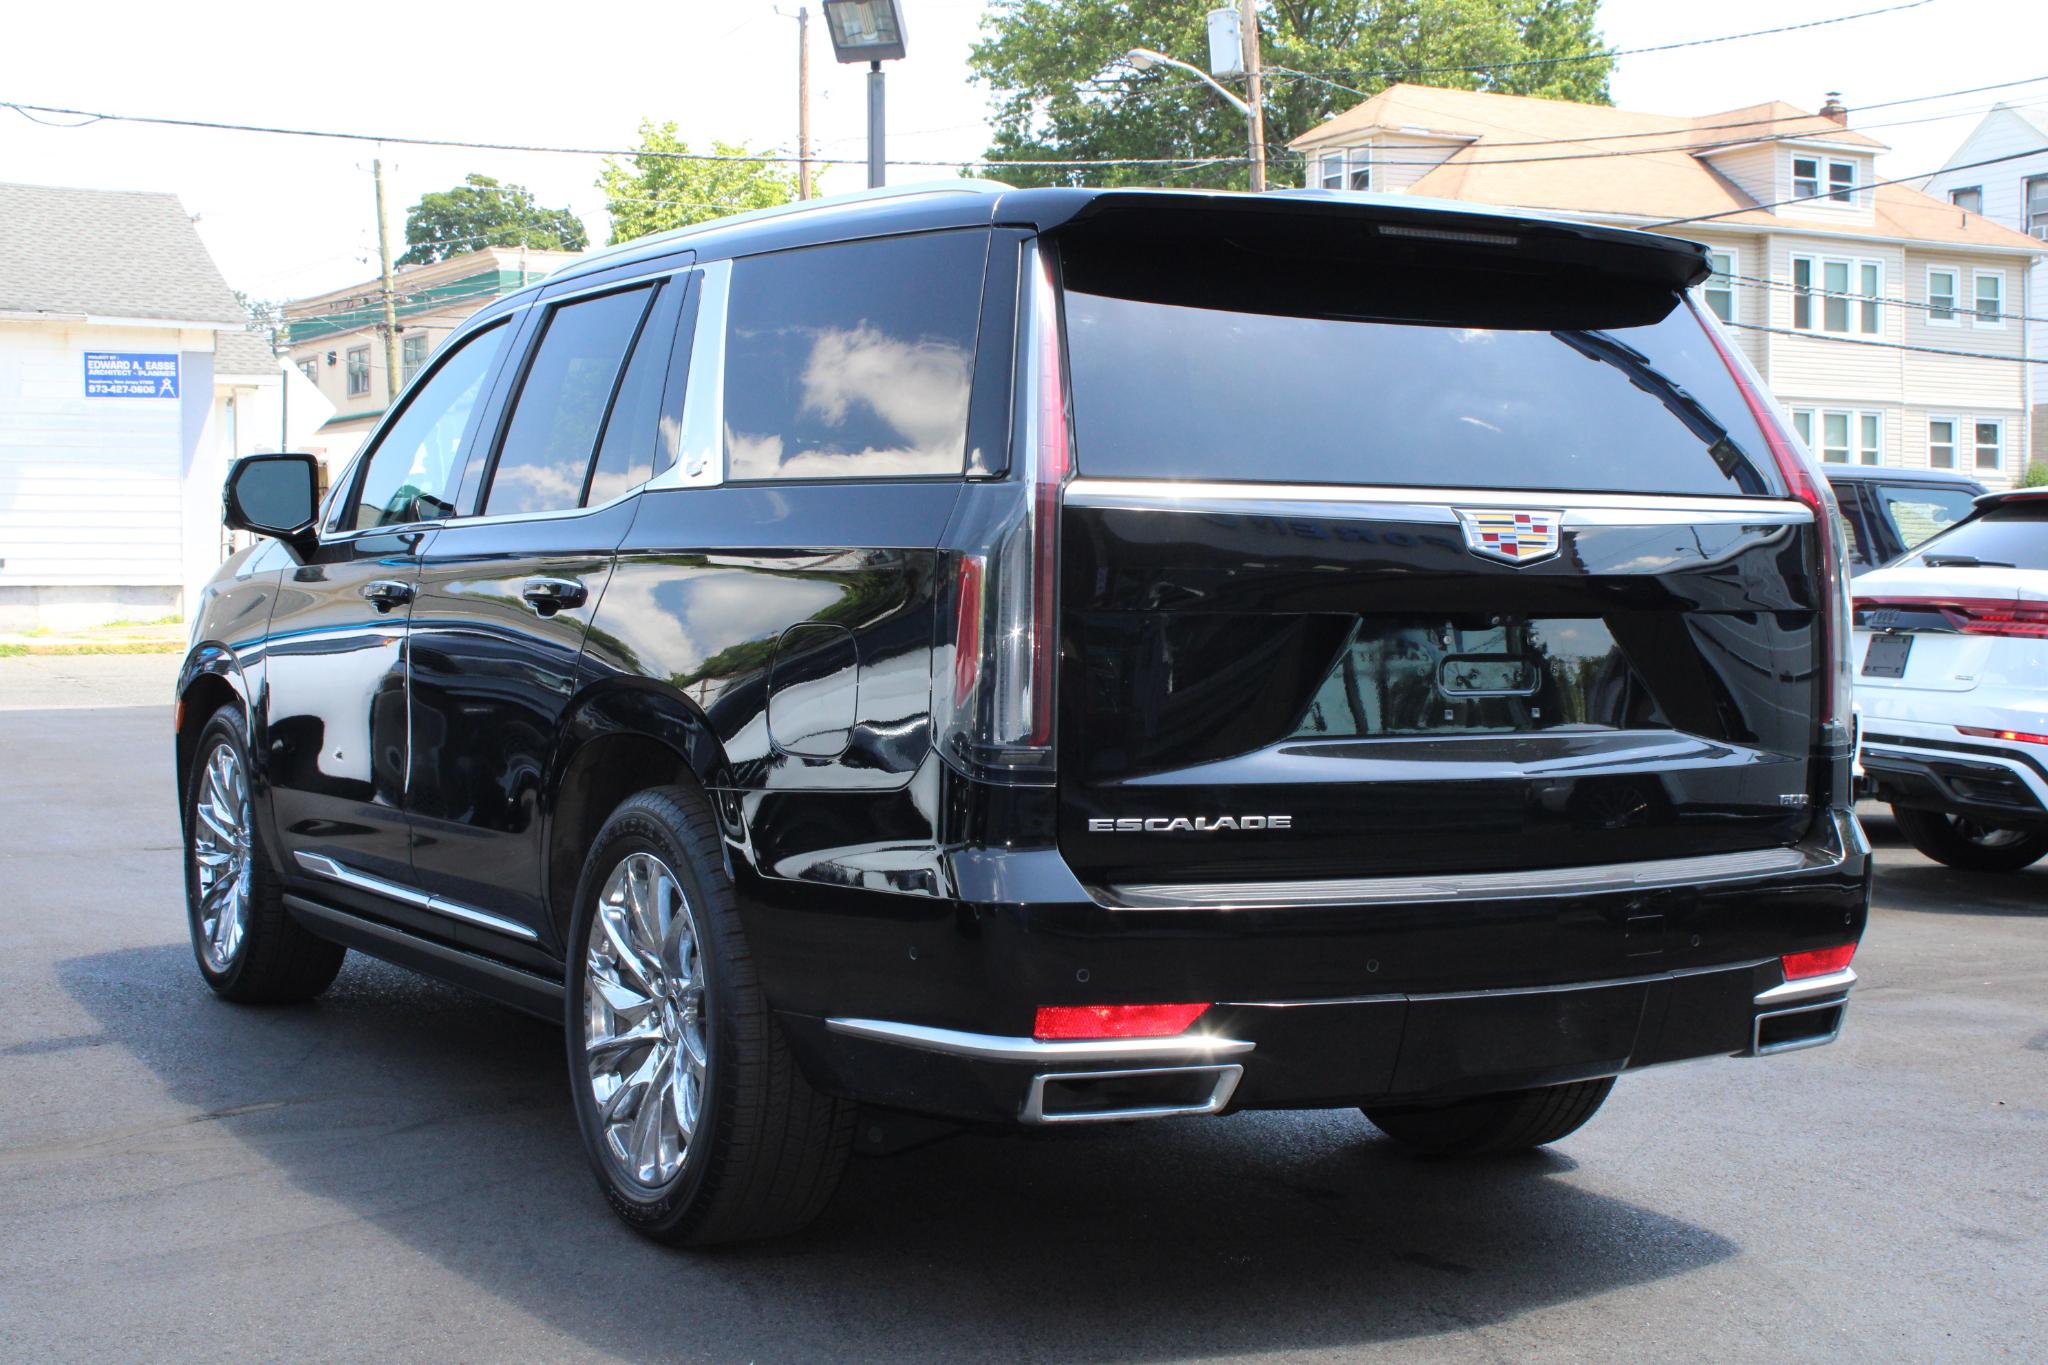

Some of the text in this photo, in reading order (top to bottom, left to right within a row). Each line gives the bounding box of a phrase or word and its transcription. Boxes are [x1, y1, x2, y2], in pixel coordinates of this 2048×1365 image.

[88, 360, 130, 370] EDWARD
[133, 361, 142, 370] A.
[1087, 814, 1293, 832] ESCALADE
